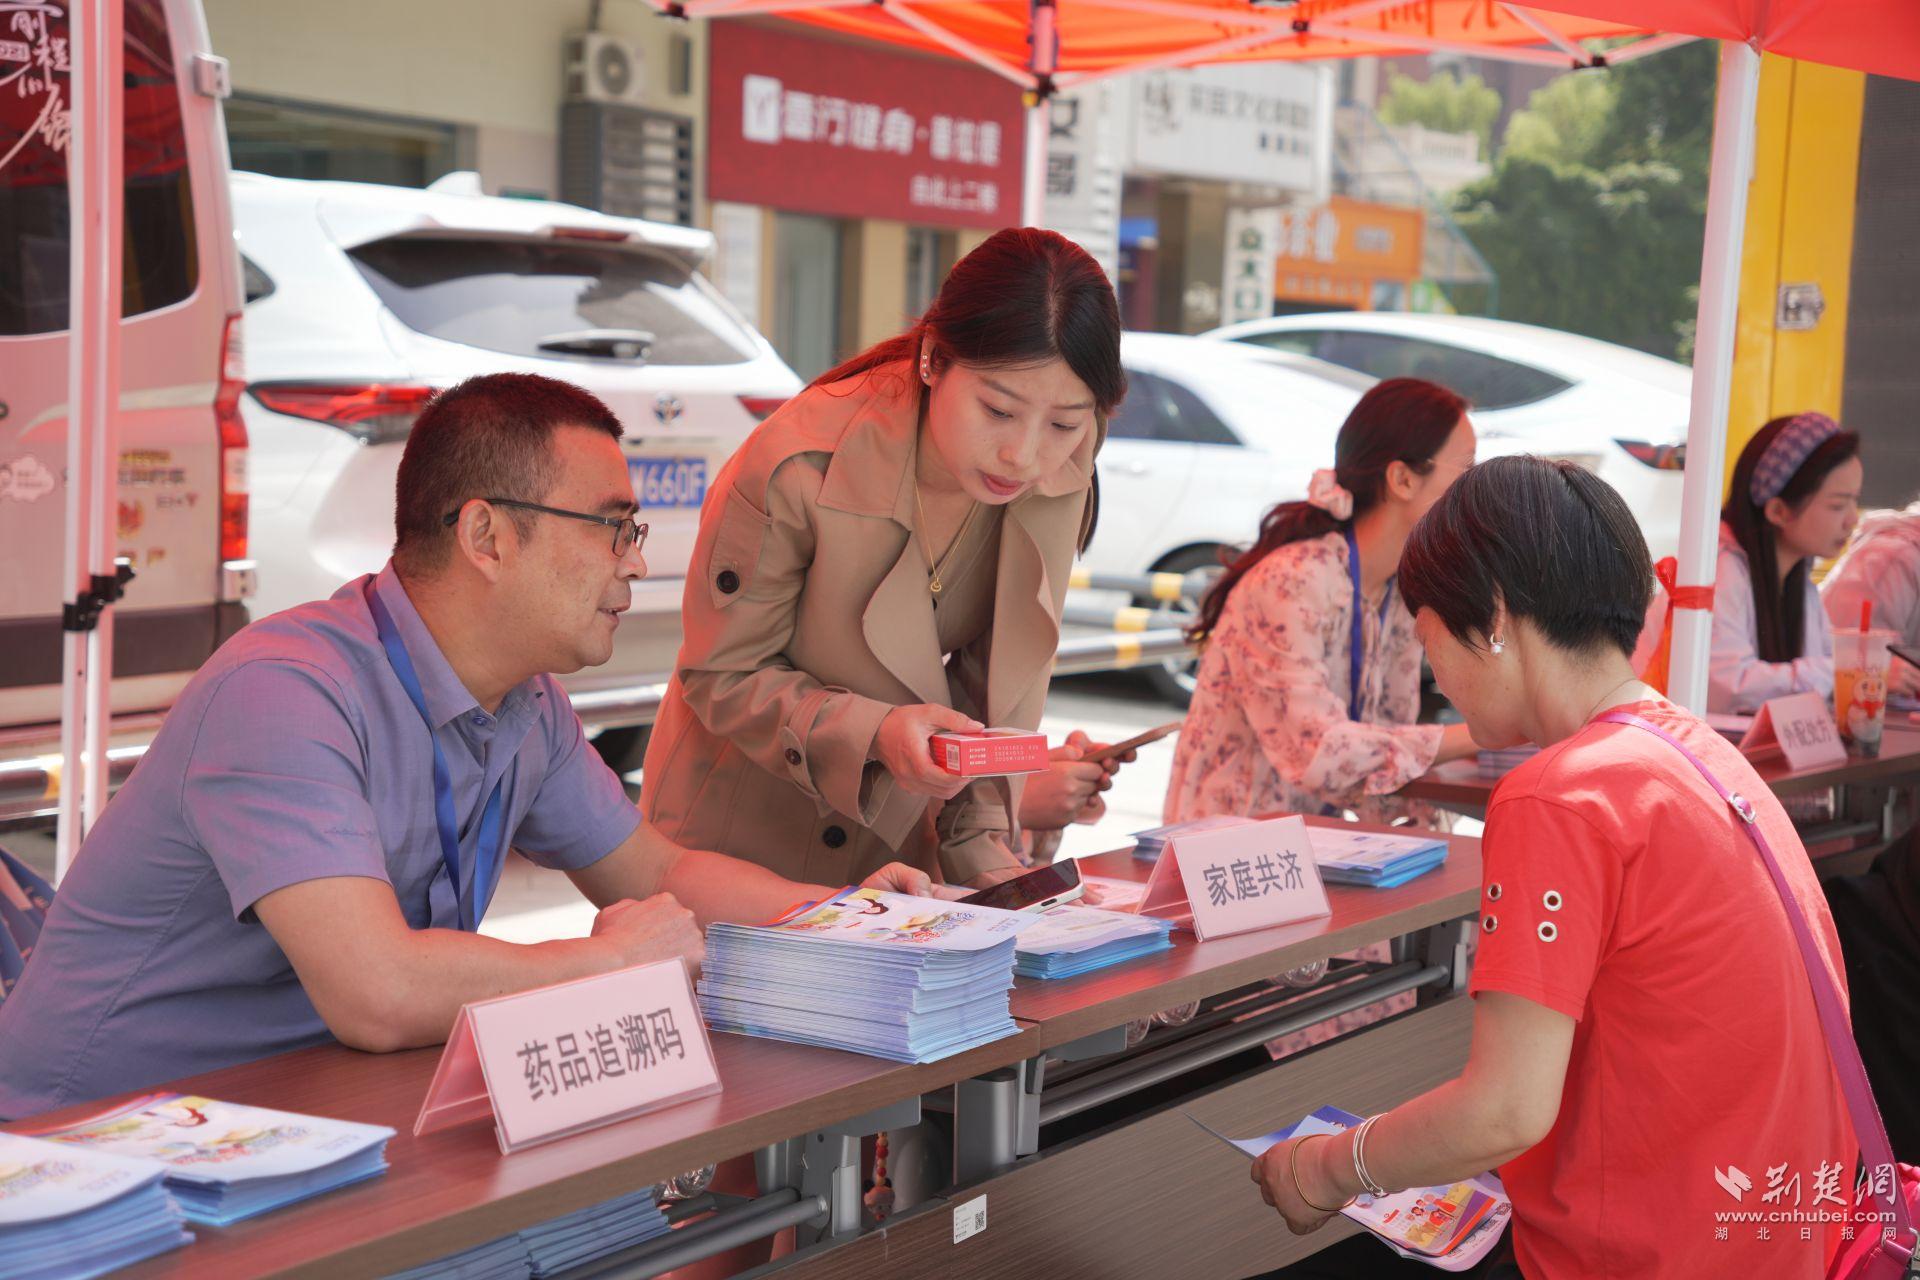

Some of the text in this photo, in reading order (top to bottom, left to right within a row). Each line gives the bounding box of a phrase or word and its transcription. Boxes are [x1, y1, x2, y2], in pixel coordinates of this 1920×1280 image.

[1203, 850, 1304, 906] 家庭共济
[516, 1007, 685, 1101] 药品追溯码
